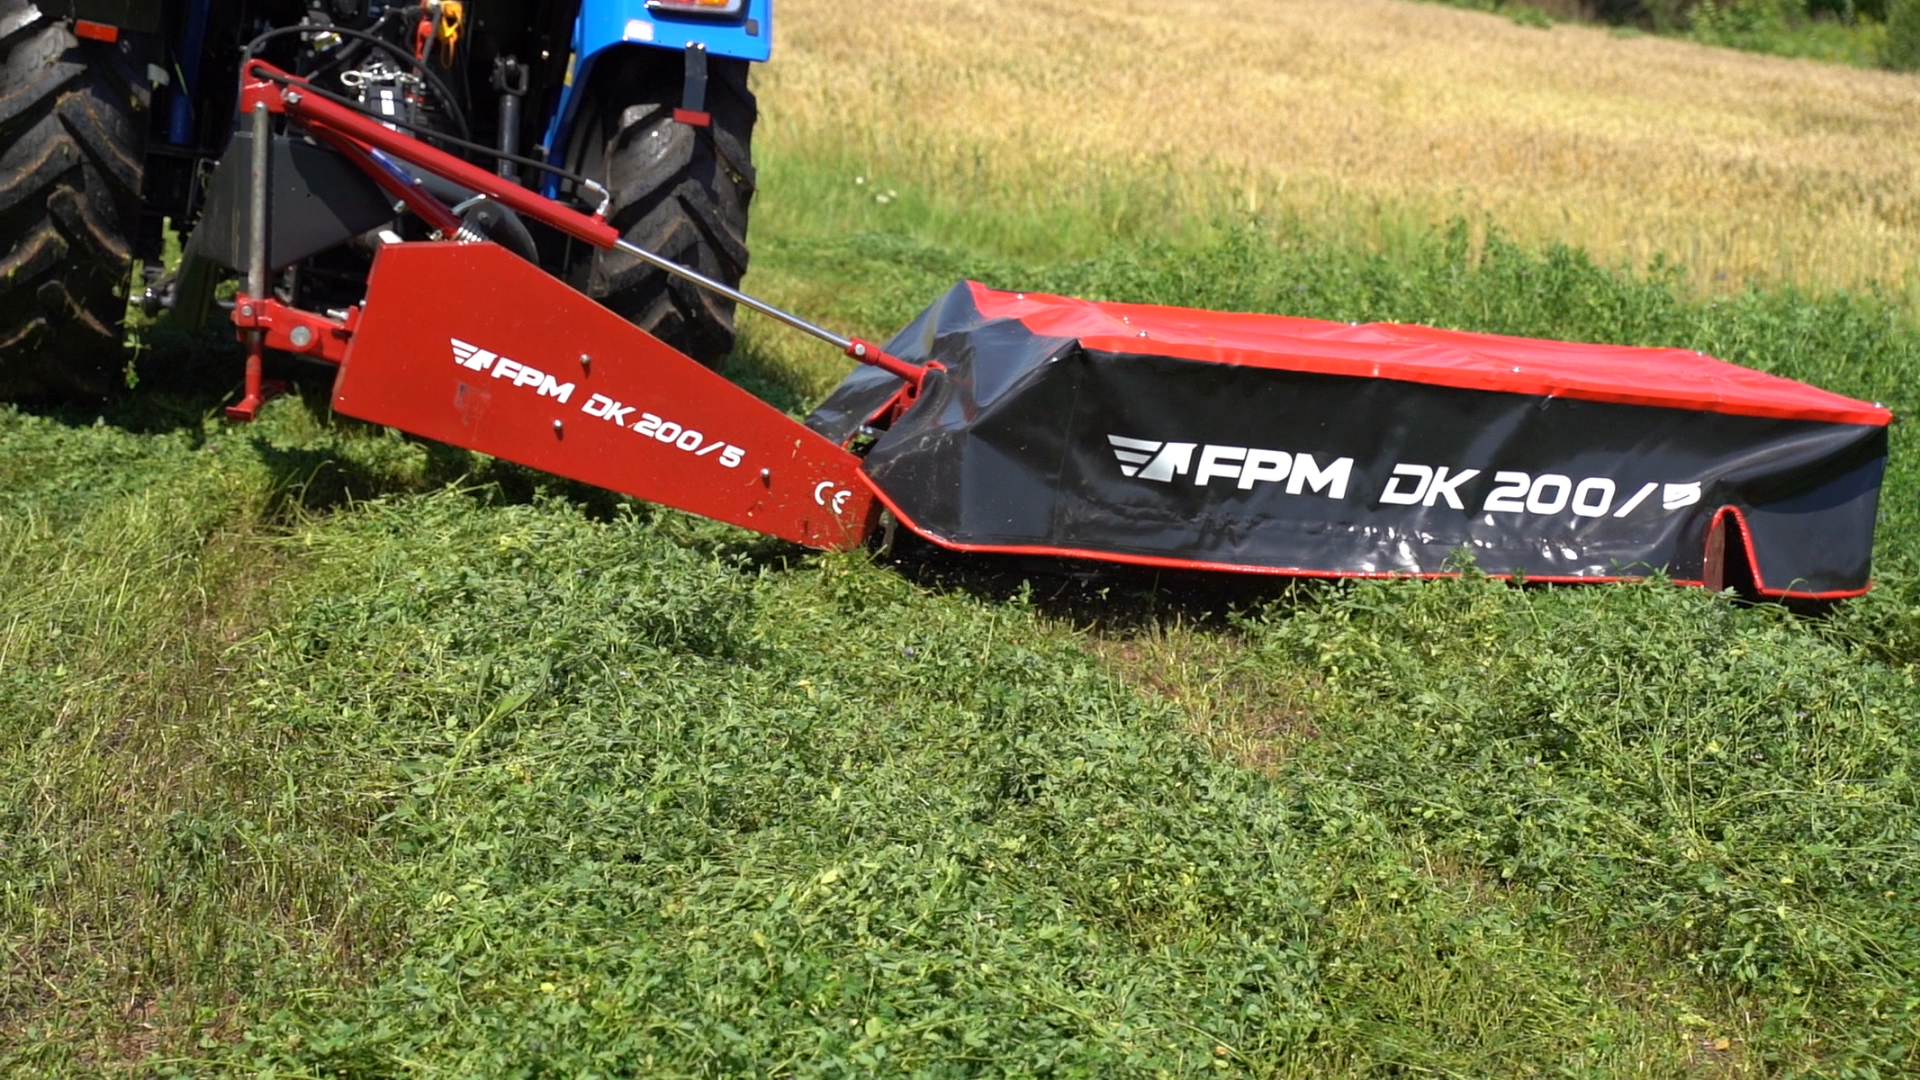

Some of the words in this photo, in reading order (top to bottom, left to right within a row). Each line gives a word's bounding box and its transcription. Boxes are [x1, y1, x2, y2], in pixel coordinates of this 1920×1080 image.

[491, 357, 575, 404] FPM
[581, 392, 636, 427] DK
[632, 412, 746, 468] 200/5
[814, 481, 852, 515] CE
[1194, 444, 1354, 500] FPM
[1380, 463, 1481, 511] DK
[1482, 471, 1702, 519] 200/5
